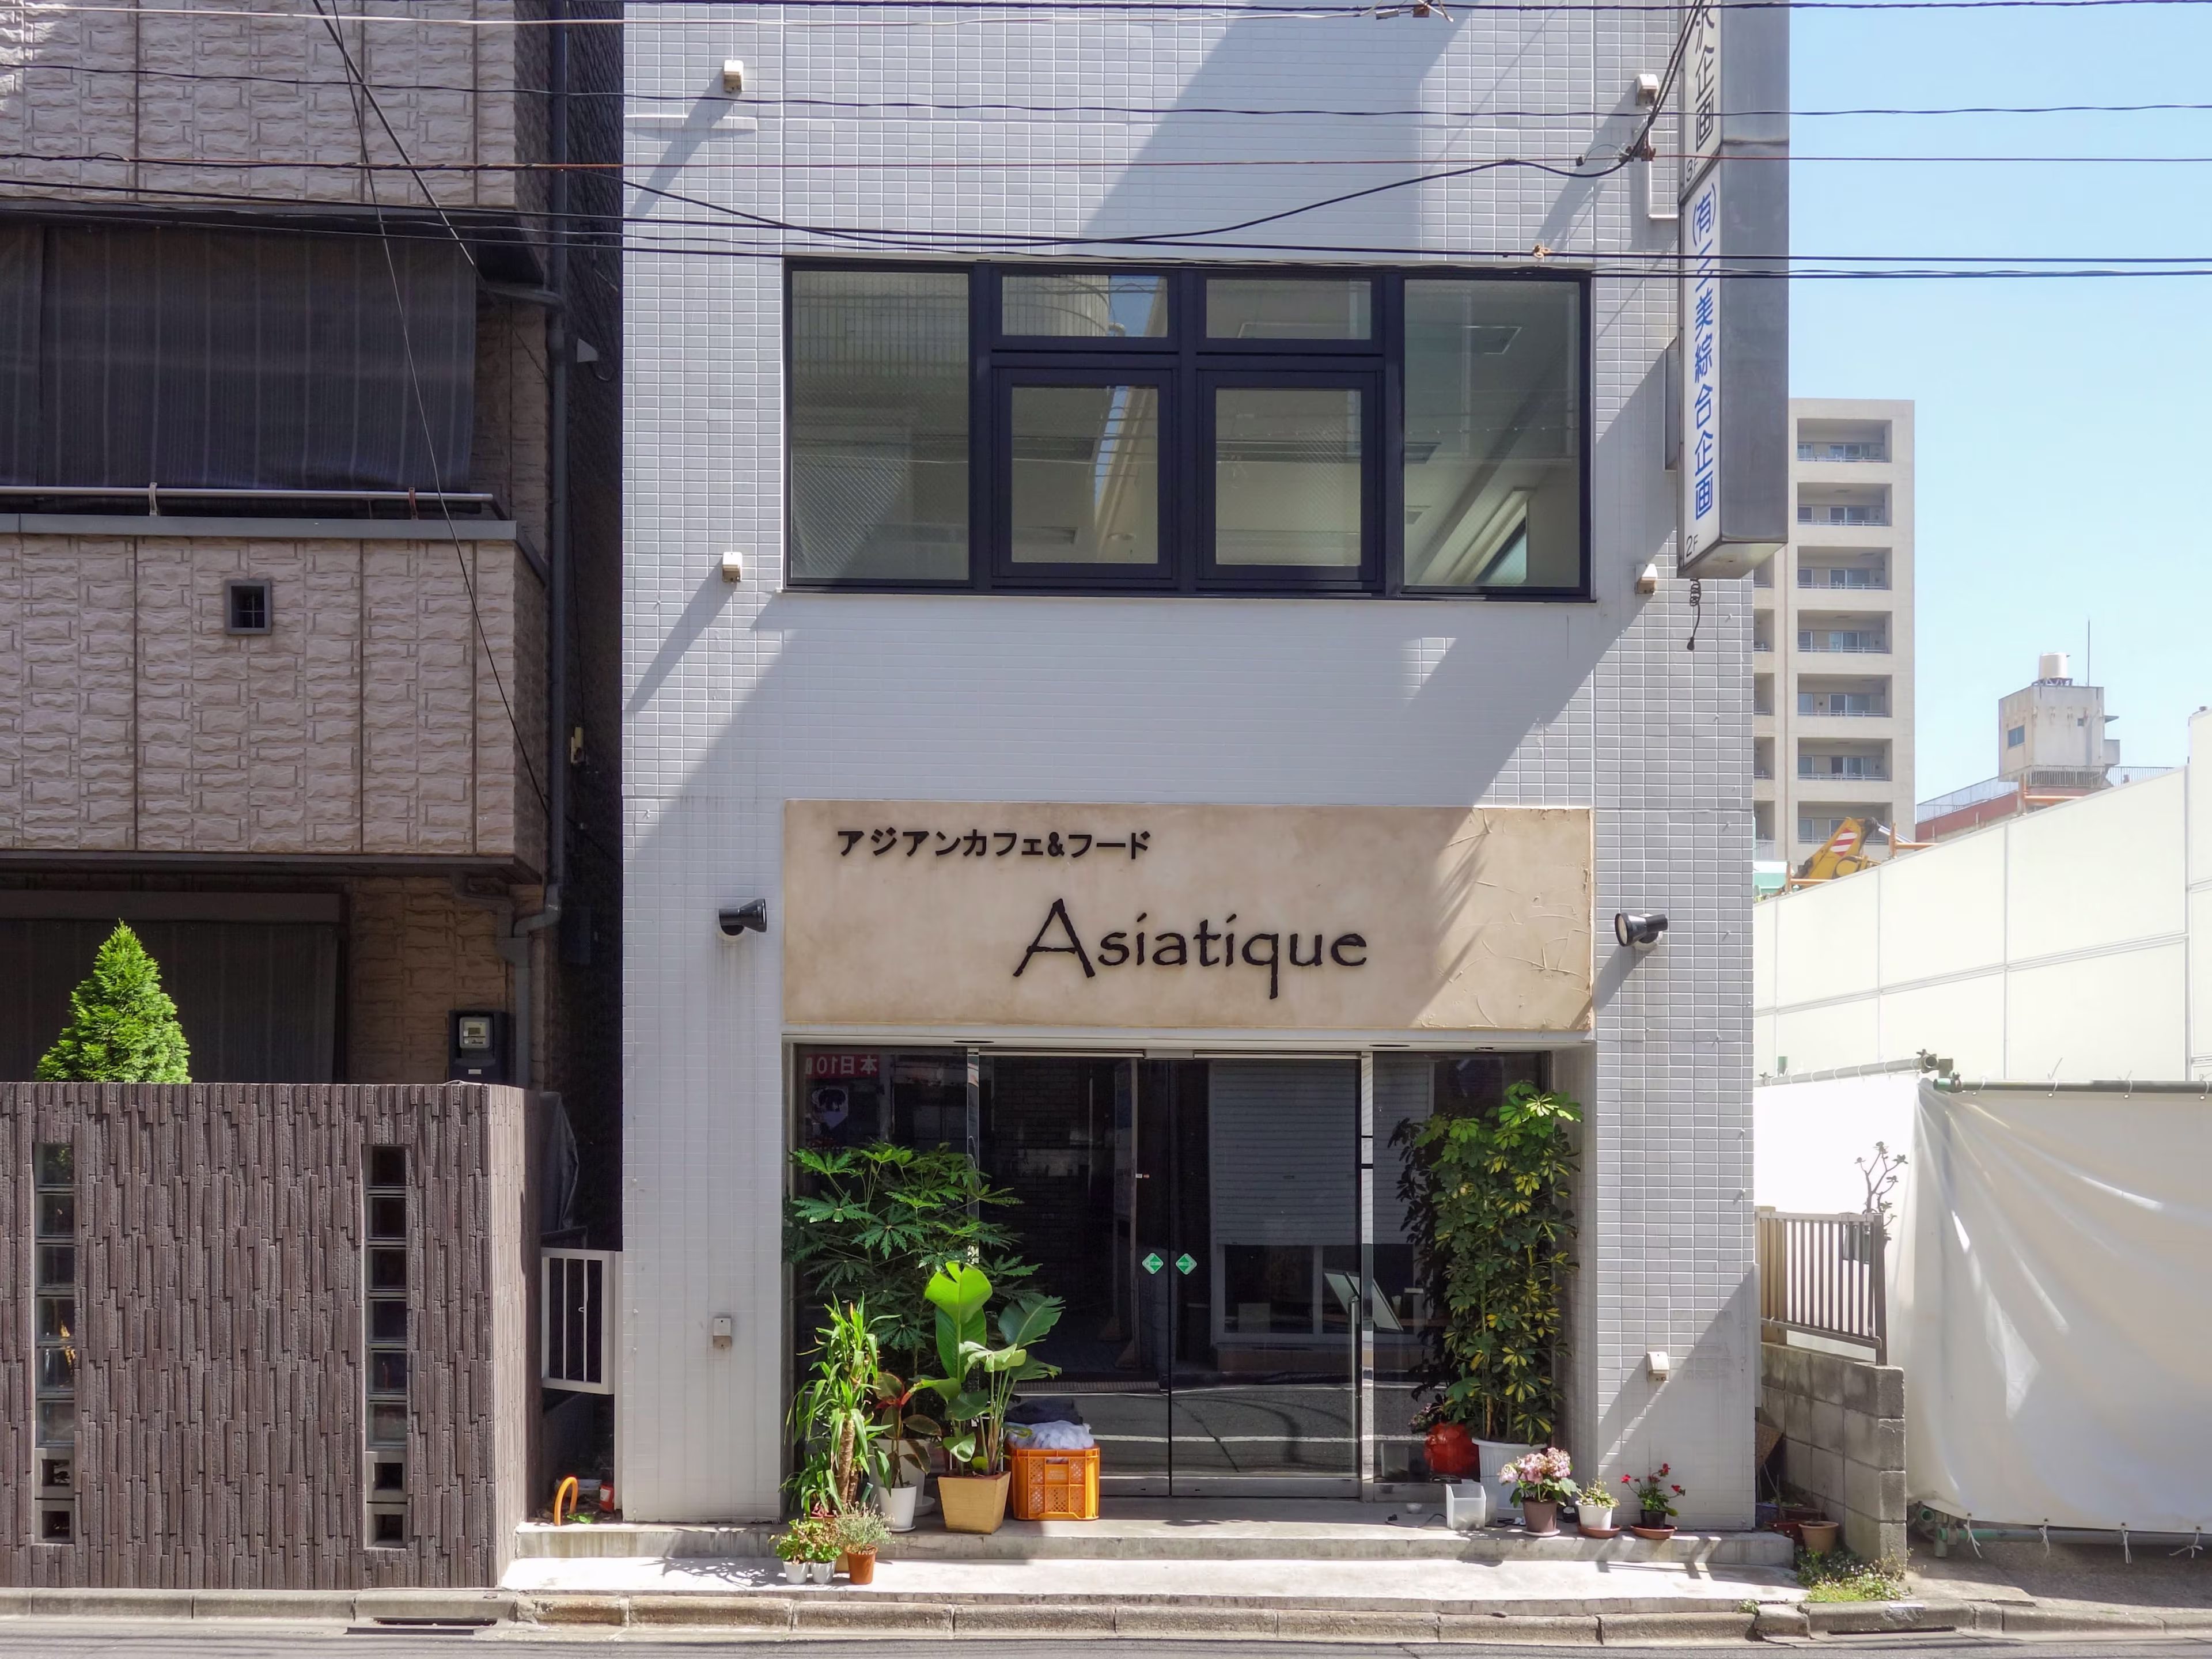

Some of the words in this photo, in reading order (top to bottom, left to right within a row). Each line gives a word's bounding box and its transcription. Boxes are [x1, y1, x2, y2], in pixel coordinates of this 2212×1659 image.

[1686, 157, 1699, 182] 3F
[1685, 534, 1699, 558] 2F
[837, 827, 1151, 860] アジアンカフェ&フード
[1012, 897, 1368, 1001] Asiatique
